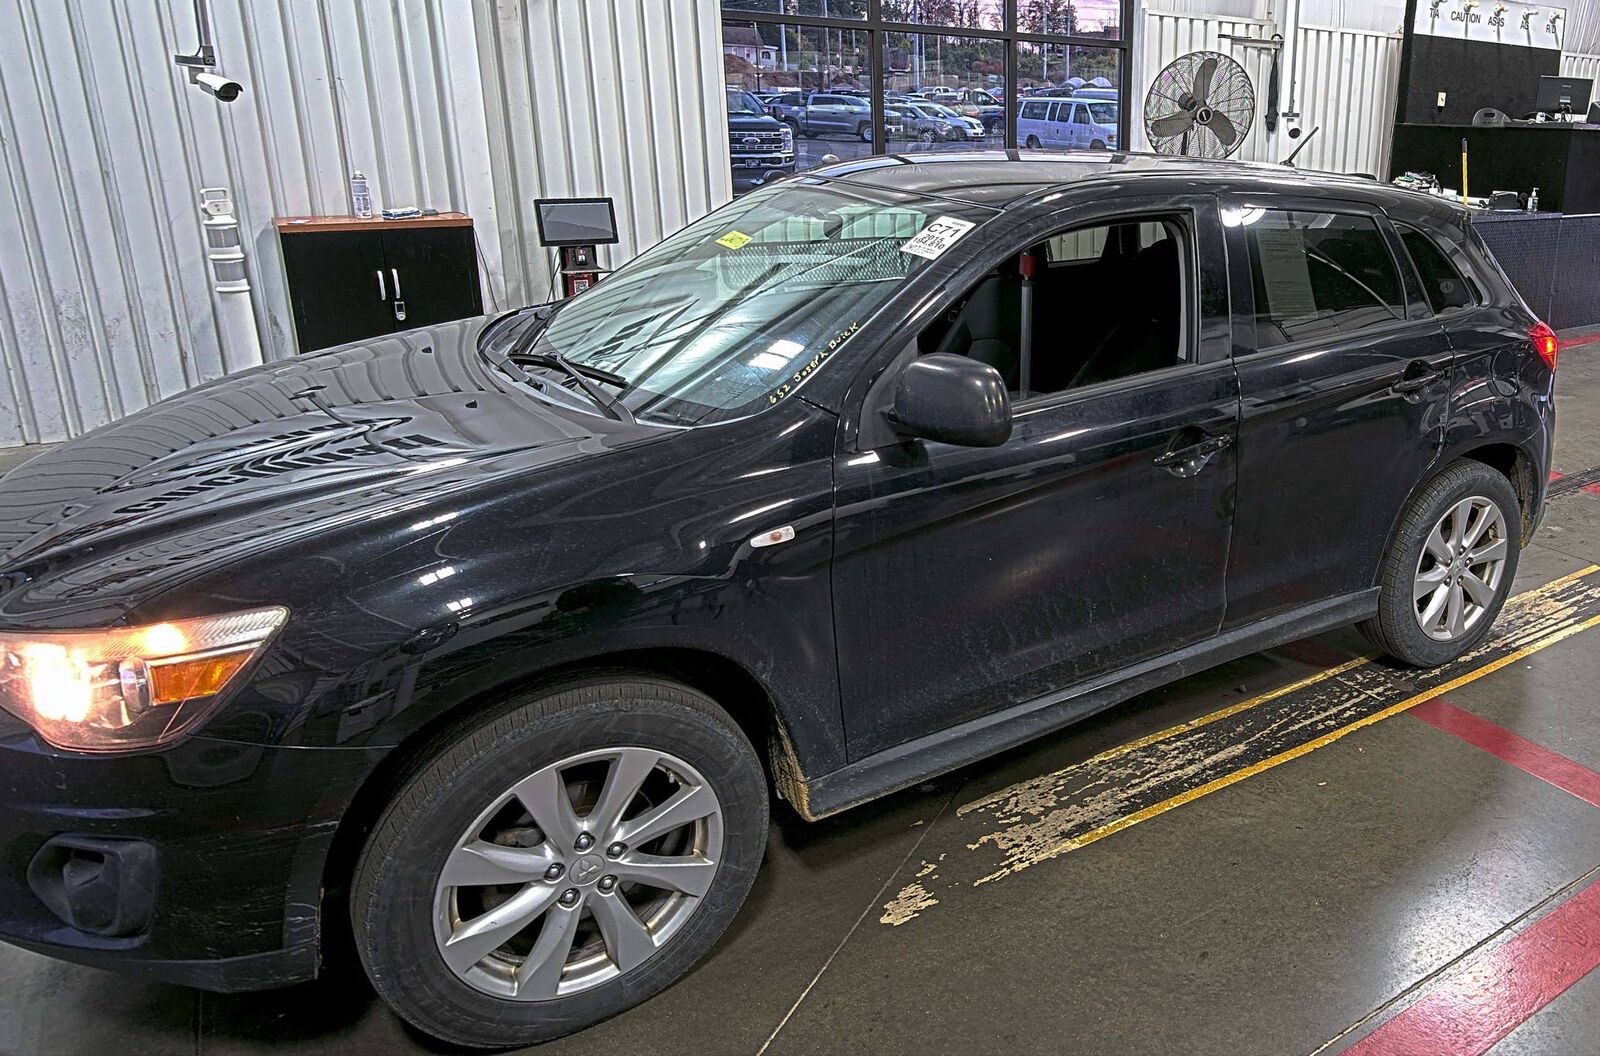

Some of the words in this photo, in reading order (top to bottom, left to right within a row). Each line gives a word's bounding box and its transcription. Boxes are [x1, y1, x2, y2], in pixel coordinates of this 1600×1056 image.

[1450, 11, 1481, 23] CAUTION
[927, 223, 962, 238] C71
[769, 384, 791, 404] 652
